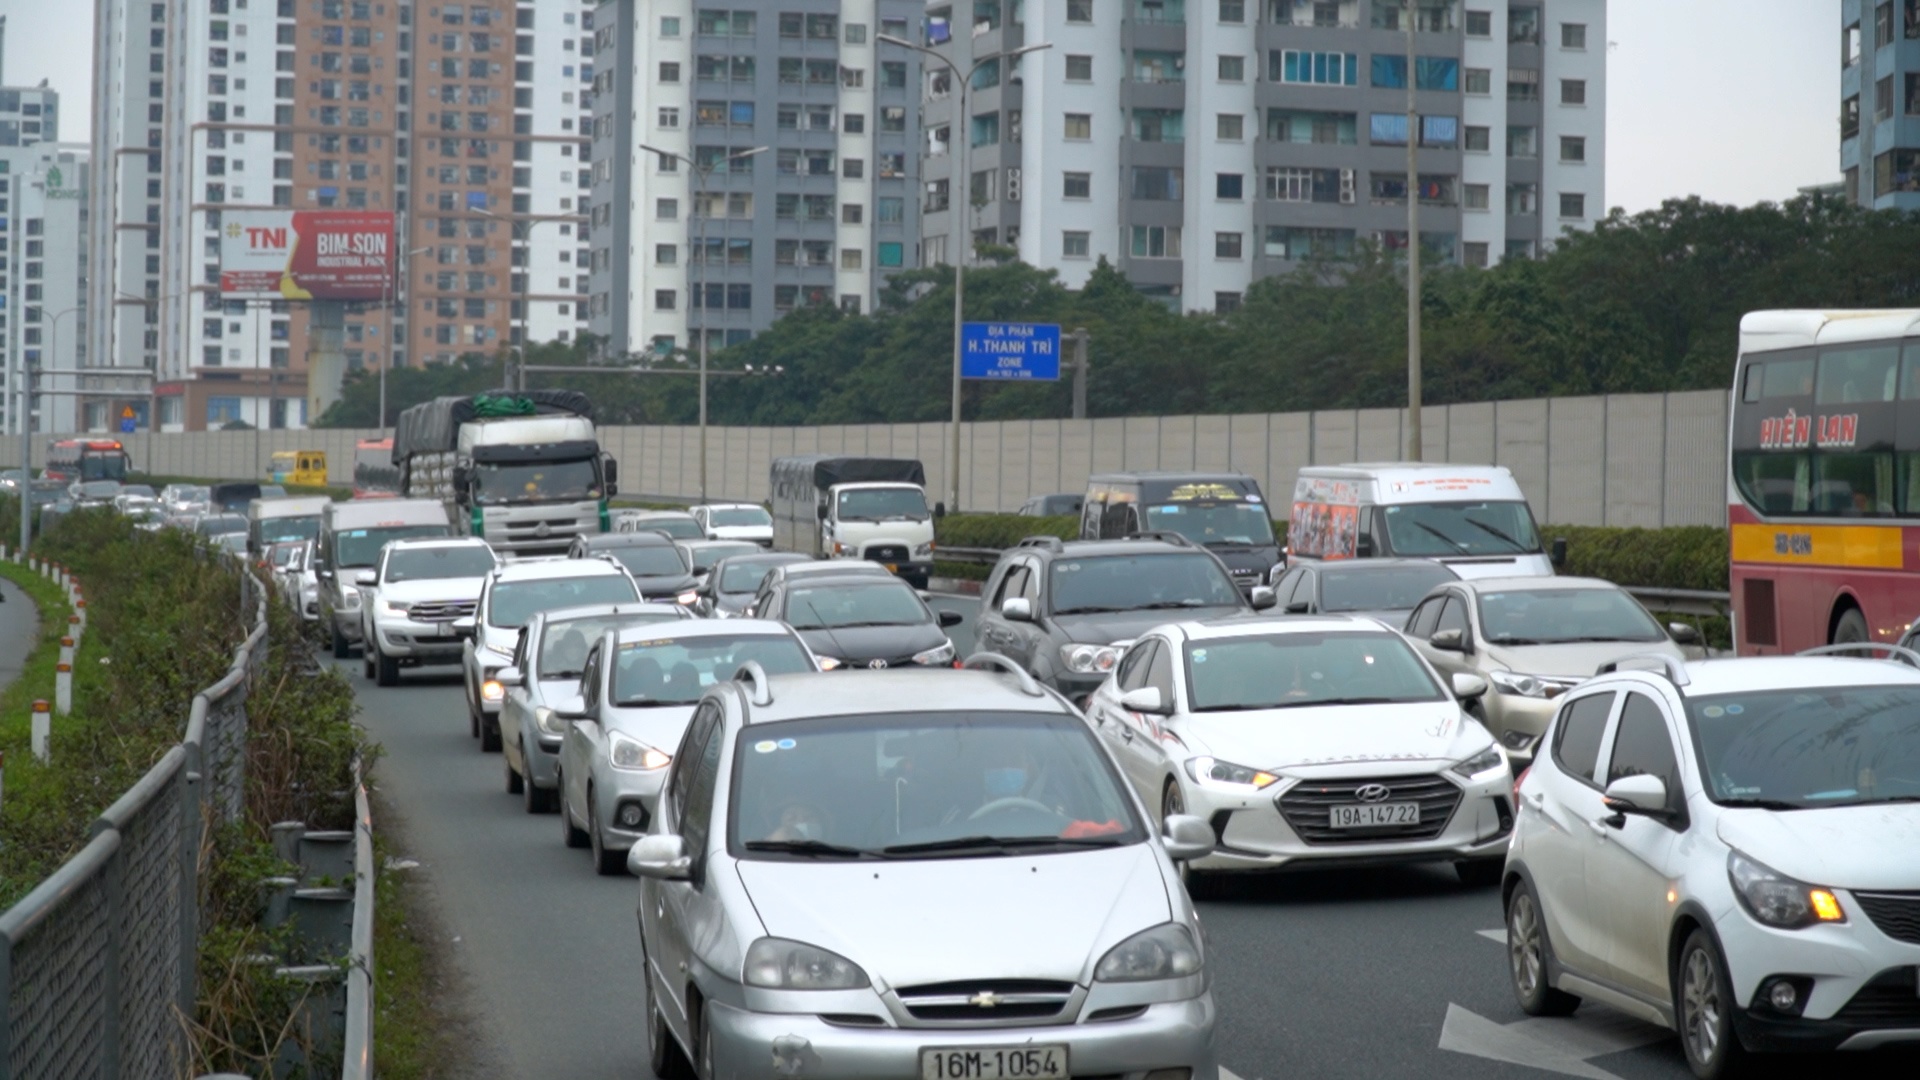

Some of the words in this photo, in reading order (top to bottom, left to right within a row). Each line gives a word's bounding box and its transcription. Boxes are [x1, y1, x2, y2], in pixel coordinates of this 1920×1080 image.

[246, 227, 287, 249] TNI
[317, 233, 349, 254] BIM
[352, 233, 387, 255] SON
[317, 256, 362, 267] INDUSTRIAL
[364, 256, 386, 267] PARK
[1032, 337, 1052, 355] TRÌ
[997, 357, 1022, 368] ZONE
[1760, 408, 1811, 449] HIỀN
[1816, 413, 1858, 447] LAN
[1335, 804, 1416, 825] 19A-147.22
[934, 1050, 1059, 1079] 16M-1054
